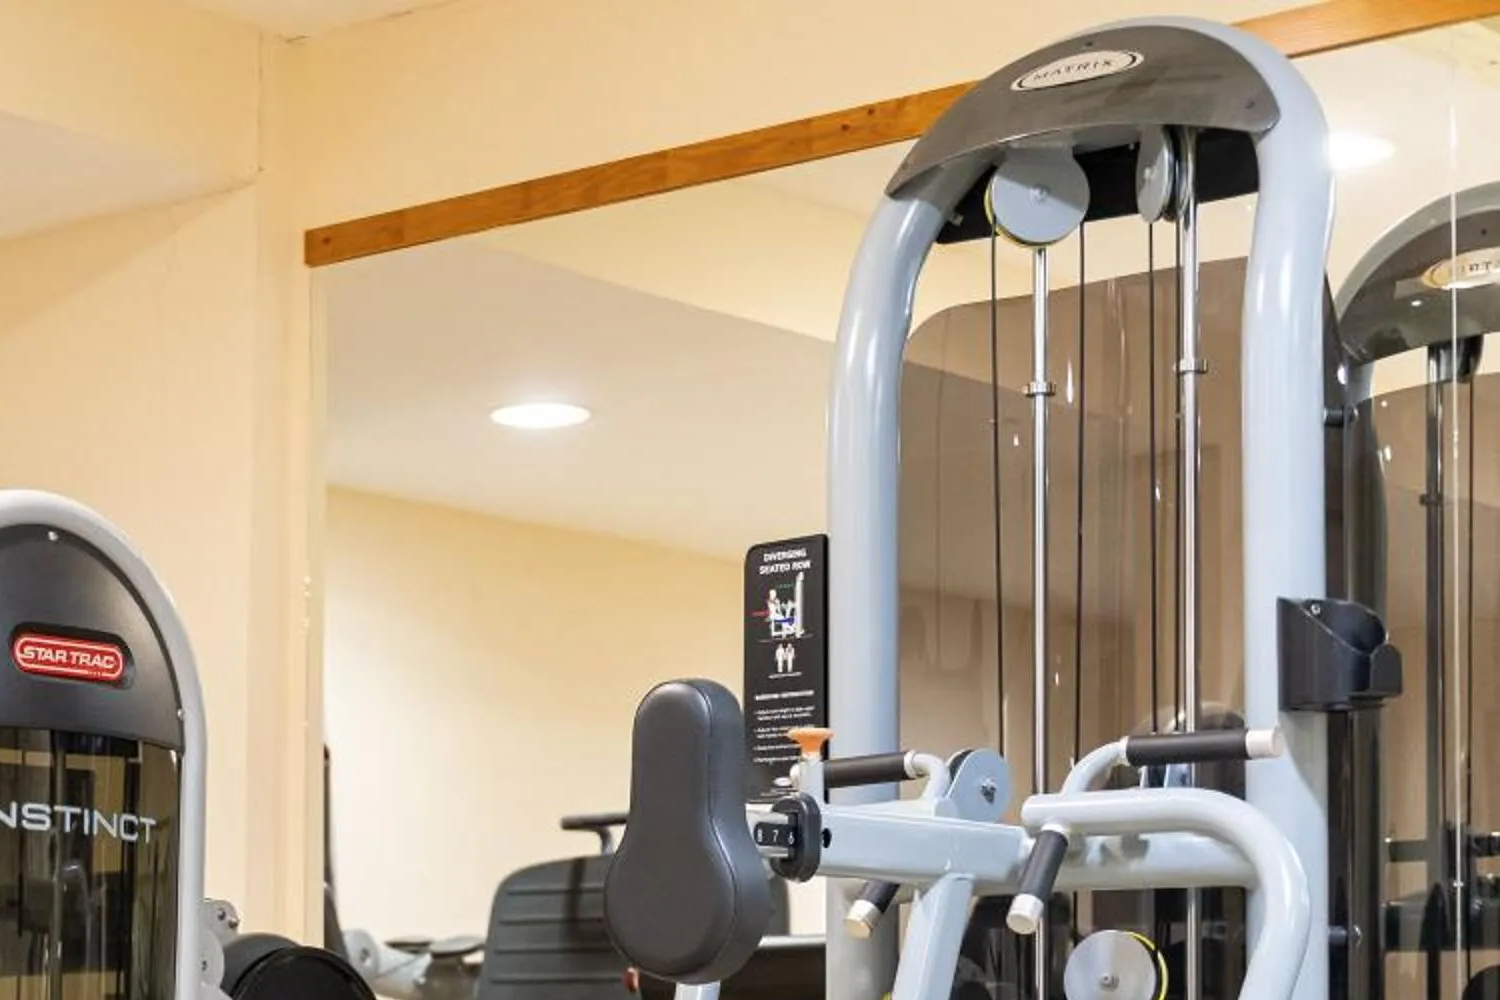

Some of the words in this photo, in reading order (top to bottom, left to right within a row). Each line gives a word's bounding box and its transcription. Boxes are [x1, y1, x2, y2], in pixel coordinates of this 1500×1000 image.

[1033, 60, 1111, 80] MATRIX
[759, 563, 790, 575] SEATED
[19, 645, 68, 663] STAR
[69, 651, 116, 669] TRAC
[772, 829, 779, 843] 7
